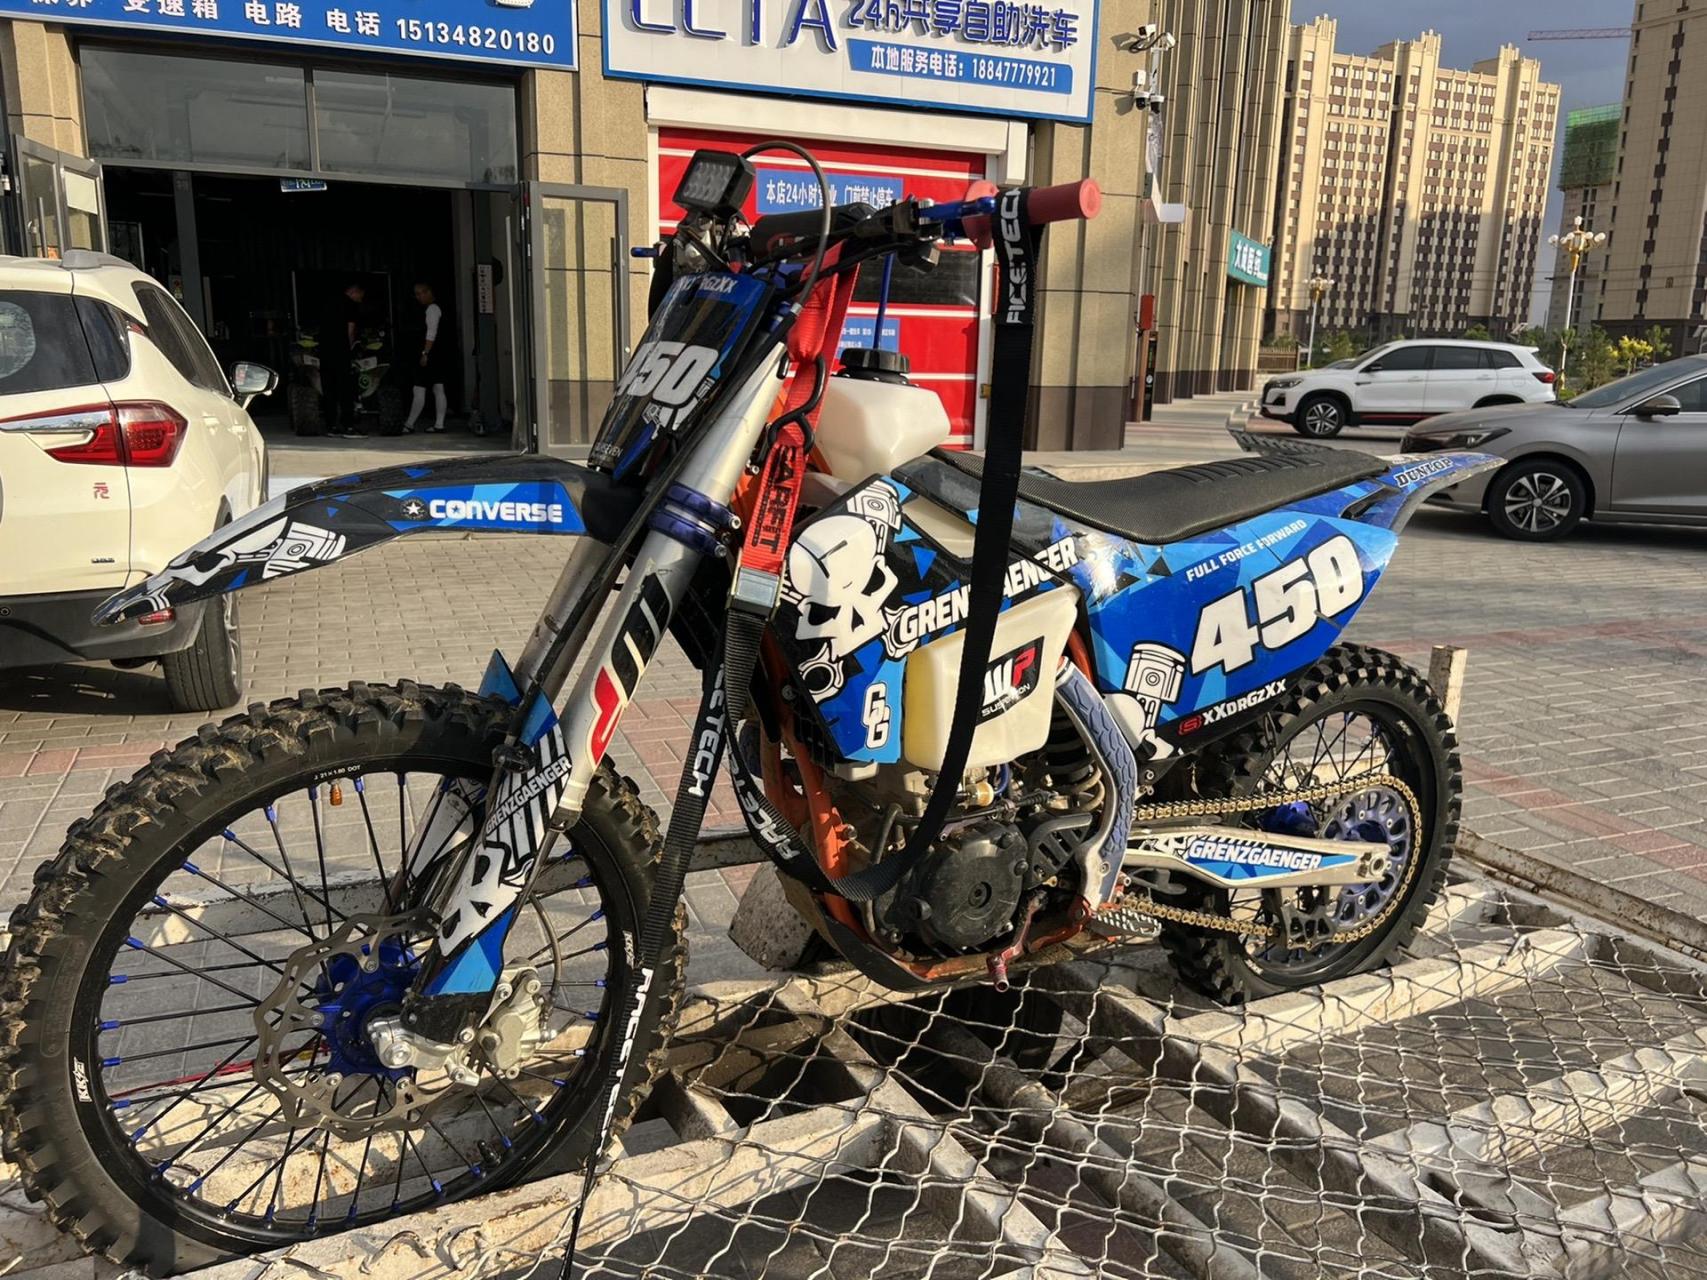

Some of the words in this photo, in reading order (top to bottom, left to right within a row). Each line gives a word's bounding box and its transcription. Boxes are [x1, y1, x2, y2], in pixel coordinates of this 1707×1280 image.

[244, 1, 303, 29] 电路
[326, 8, 380, 36] 电话
[396, 19, 555, 54] 15134820180
[849, 0, 1079, 49] 24h共享自助洗车
[972, 58, 1056, 87] 18847779921
[1394, 458, 1453, 487] DUNLOP
[429, 499, 563, 523] CONVERSE
[1186, 559, 1220, 582] FULL
[1218, 542, 1257, 566] FORCE
[1255, 519, 1308, 550] FORWARD
[900, 537, 1078, 643] GRENAENGER
[1192, 535, 1364, 675] 450
[486, 755, 573, 834] GRENZGAENGER
[1189, 840, 1322, 870] GRENZGAENGER
